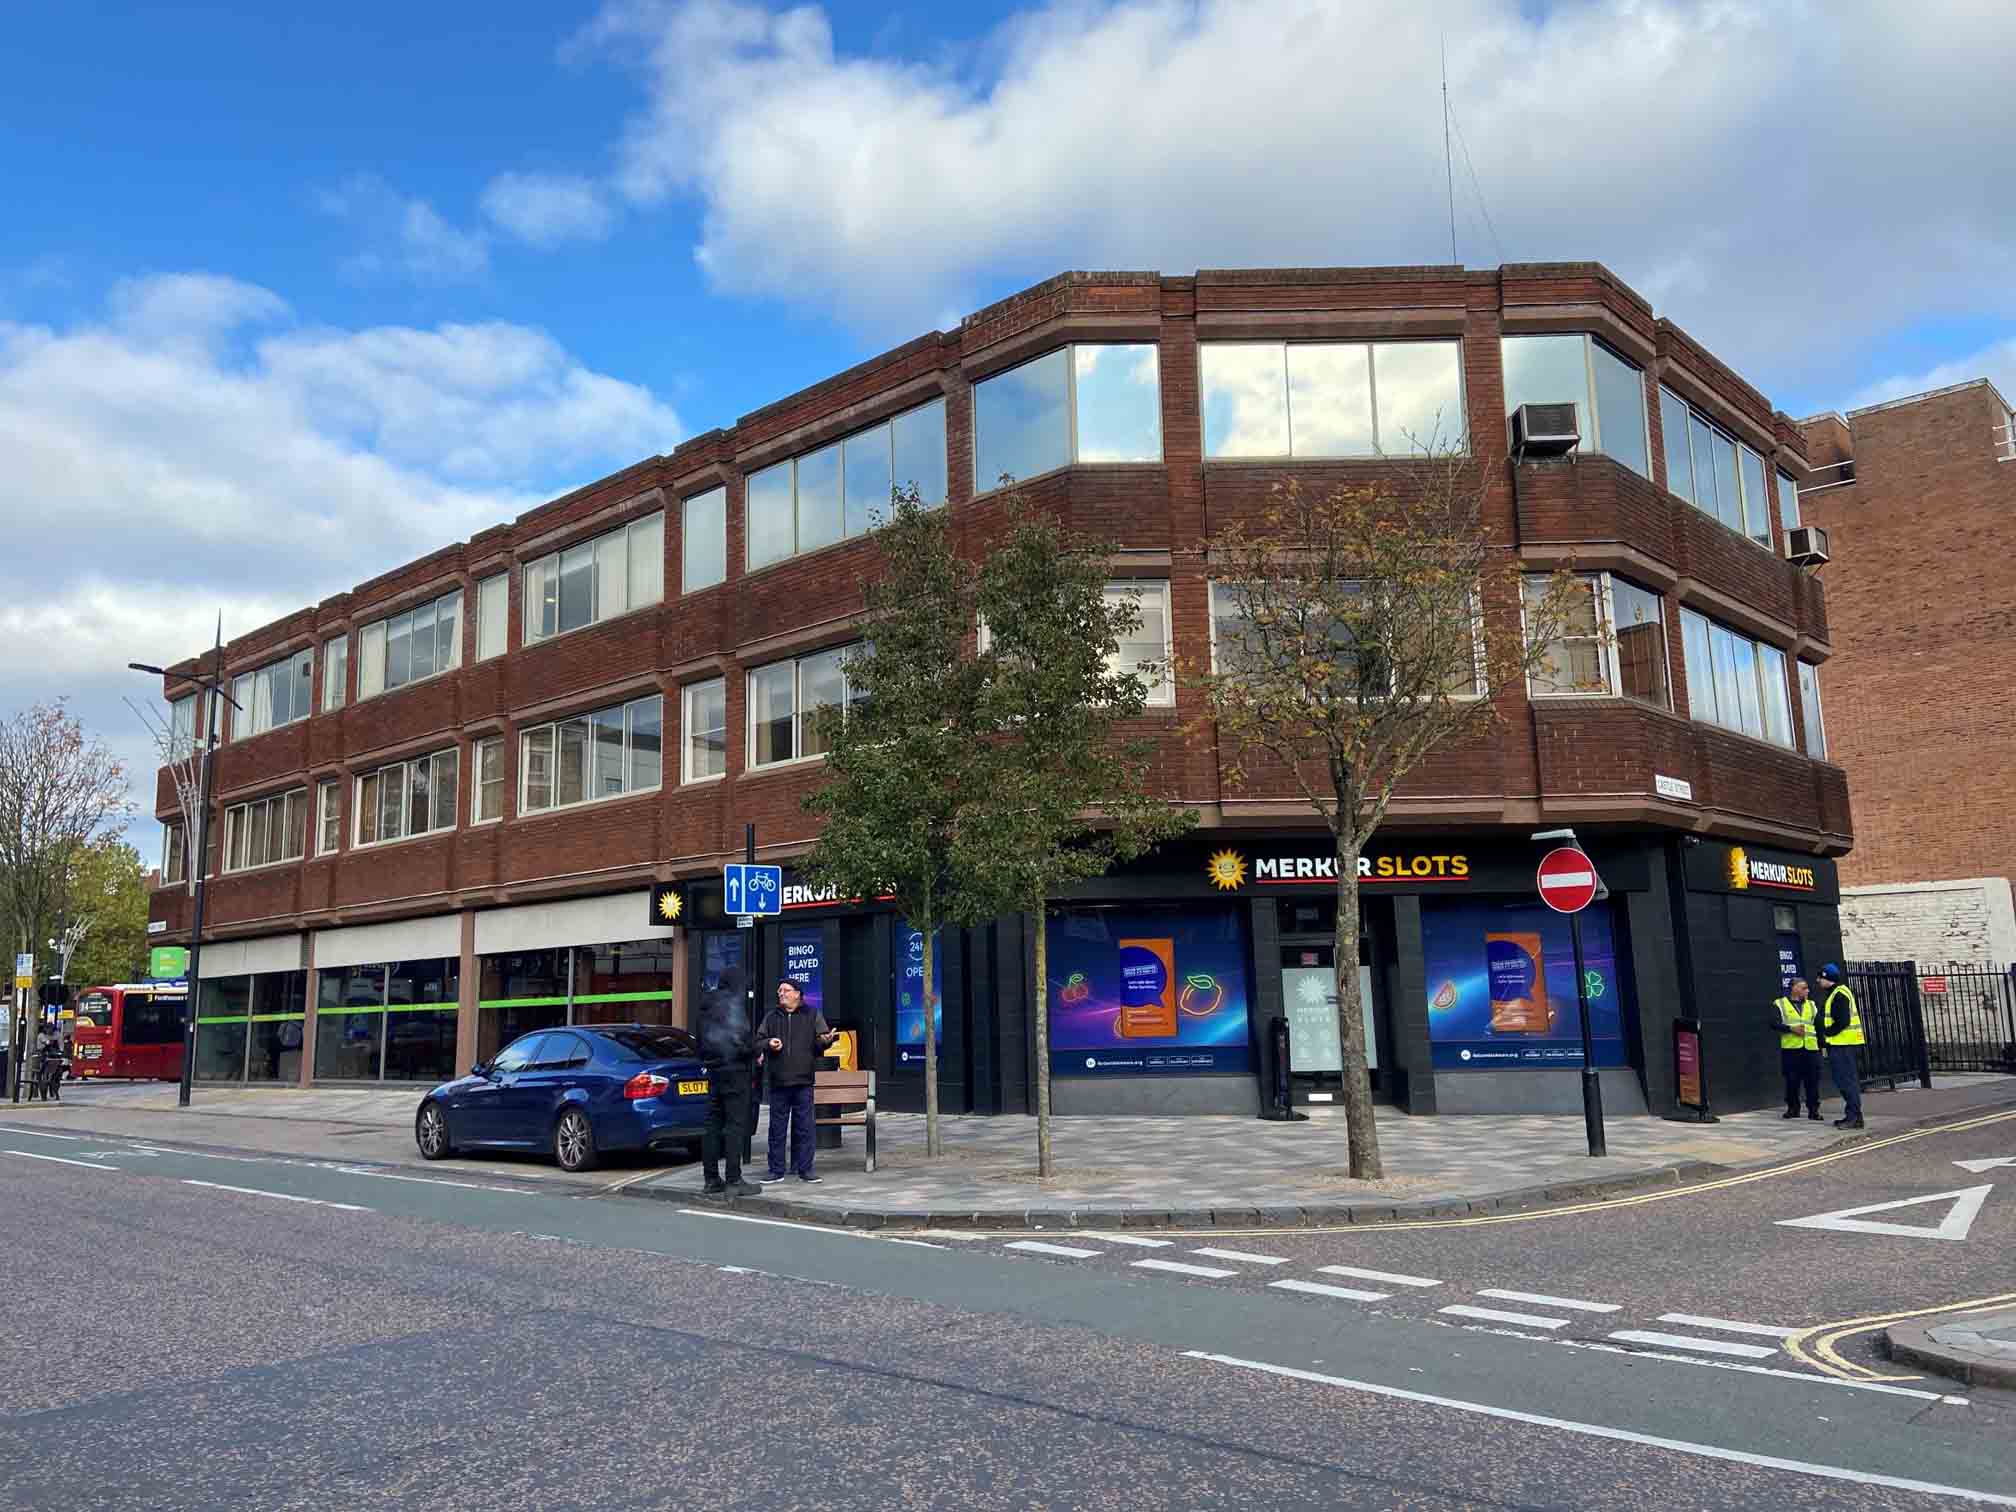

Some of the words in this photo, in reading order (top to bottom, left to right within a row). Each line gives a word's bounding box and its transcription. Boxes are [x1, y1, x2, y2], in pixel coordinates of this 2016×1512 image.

[1256, 856, 1371, 878] MERKR
[1377, 855, 1469, 877] SLOTS
[1750, 860, 1787, 883] MERKUR
[1786, 866, 1814, 887] SLOTS
[788, 945, 814, 956] BINGO
[788, 958, 819, 970] PLAYED
[906, 967, 925, 977] OPE
